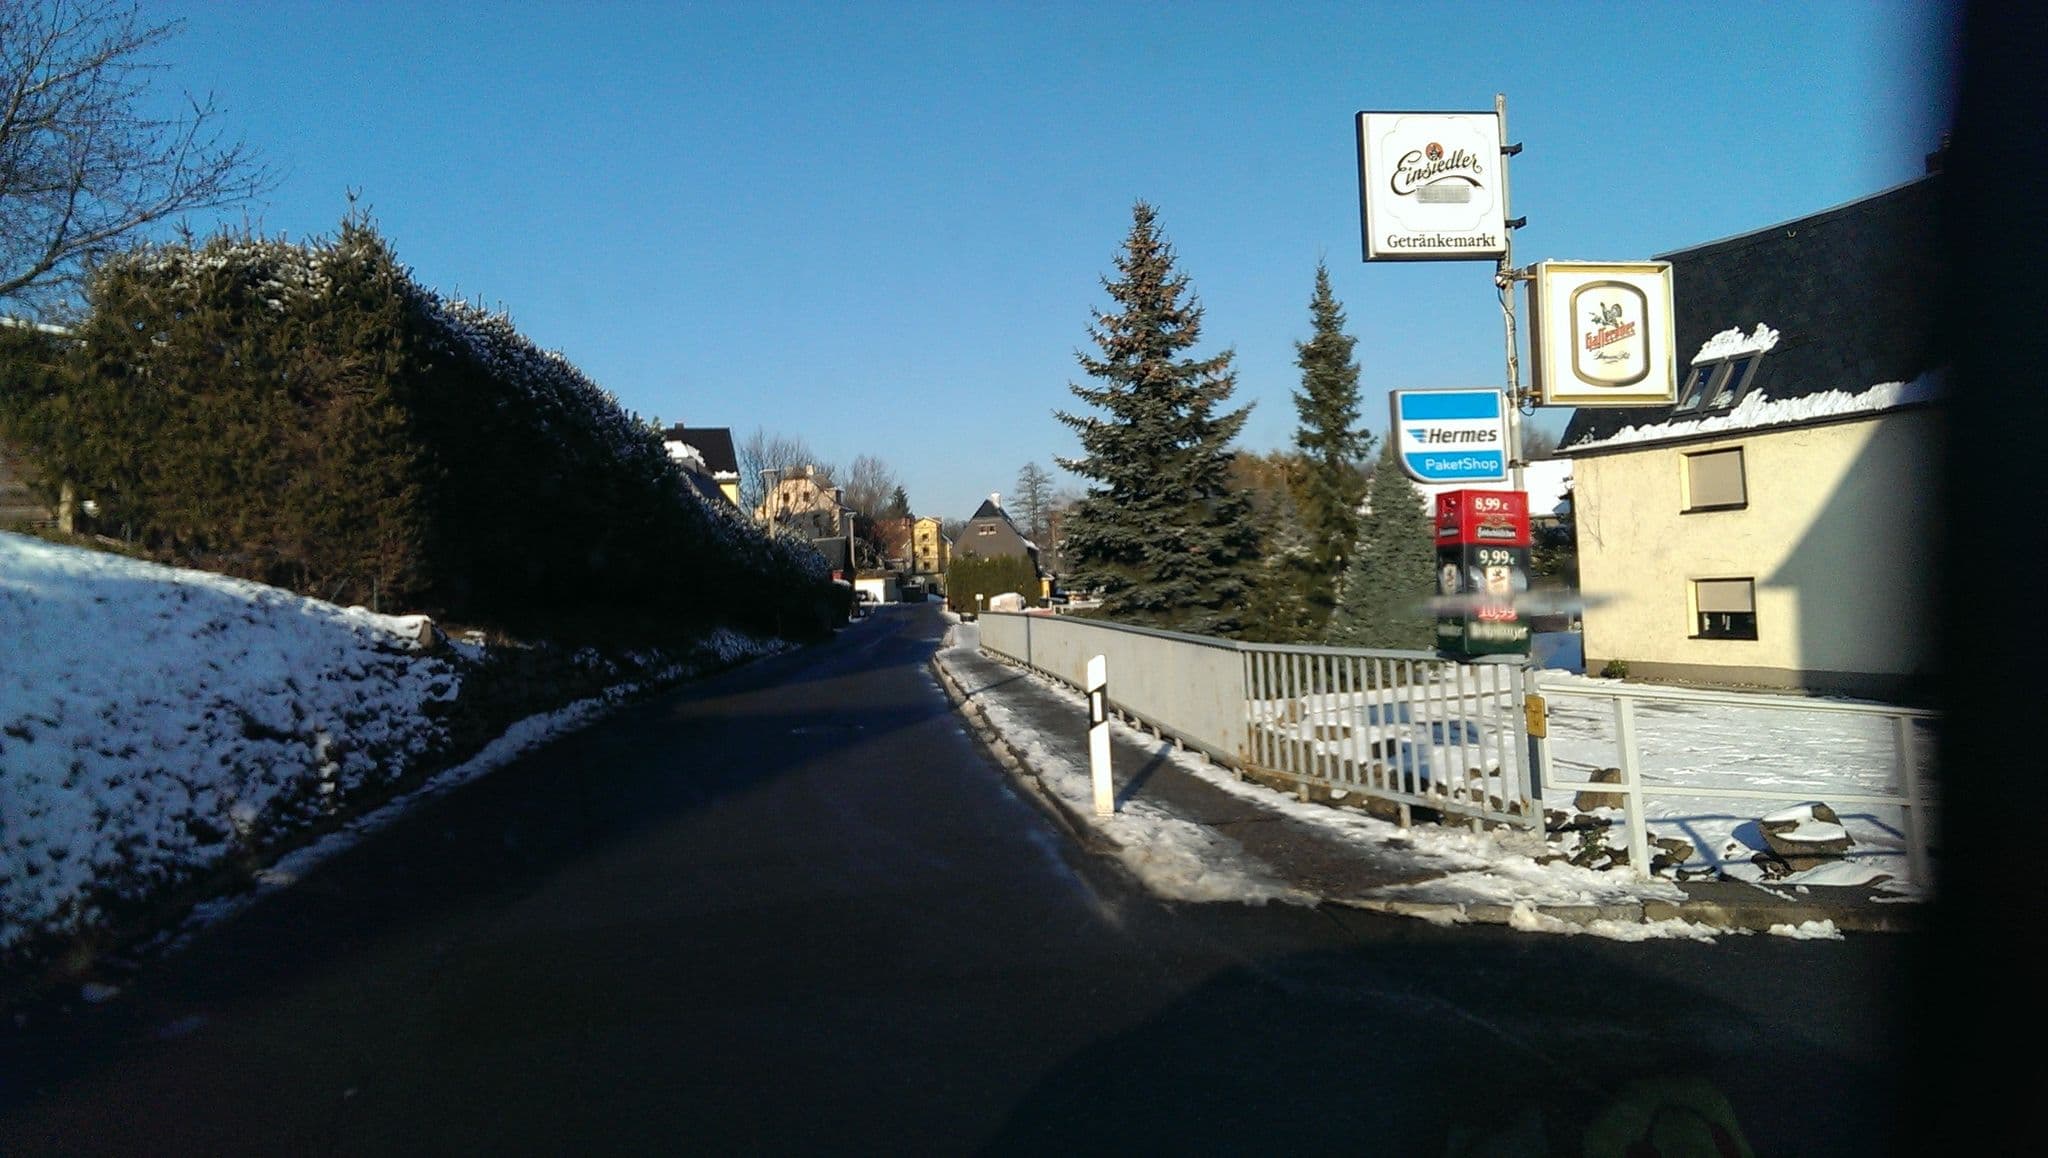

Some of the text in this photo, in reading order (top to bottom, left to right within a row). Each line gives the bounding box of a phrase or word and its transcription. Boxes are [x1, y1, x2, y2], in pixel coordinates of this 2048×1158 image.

[1391, 149, 1483, 196] Einsiedler
[1387, 233, 1497, 248] Getränkemarkt
[1428, 428, 1498, 444] Hermes
[1425, 457, 1498, 471] PaketShop
[1475, 497, 1501, 512] 8,99
[1479, 550, 1510, 566] 9,99
